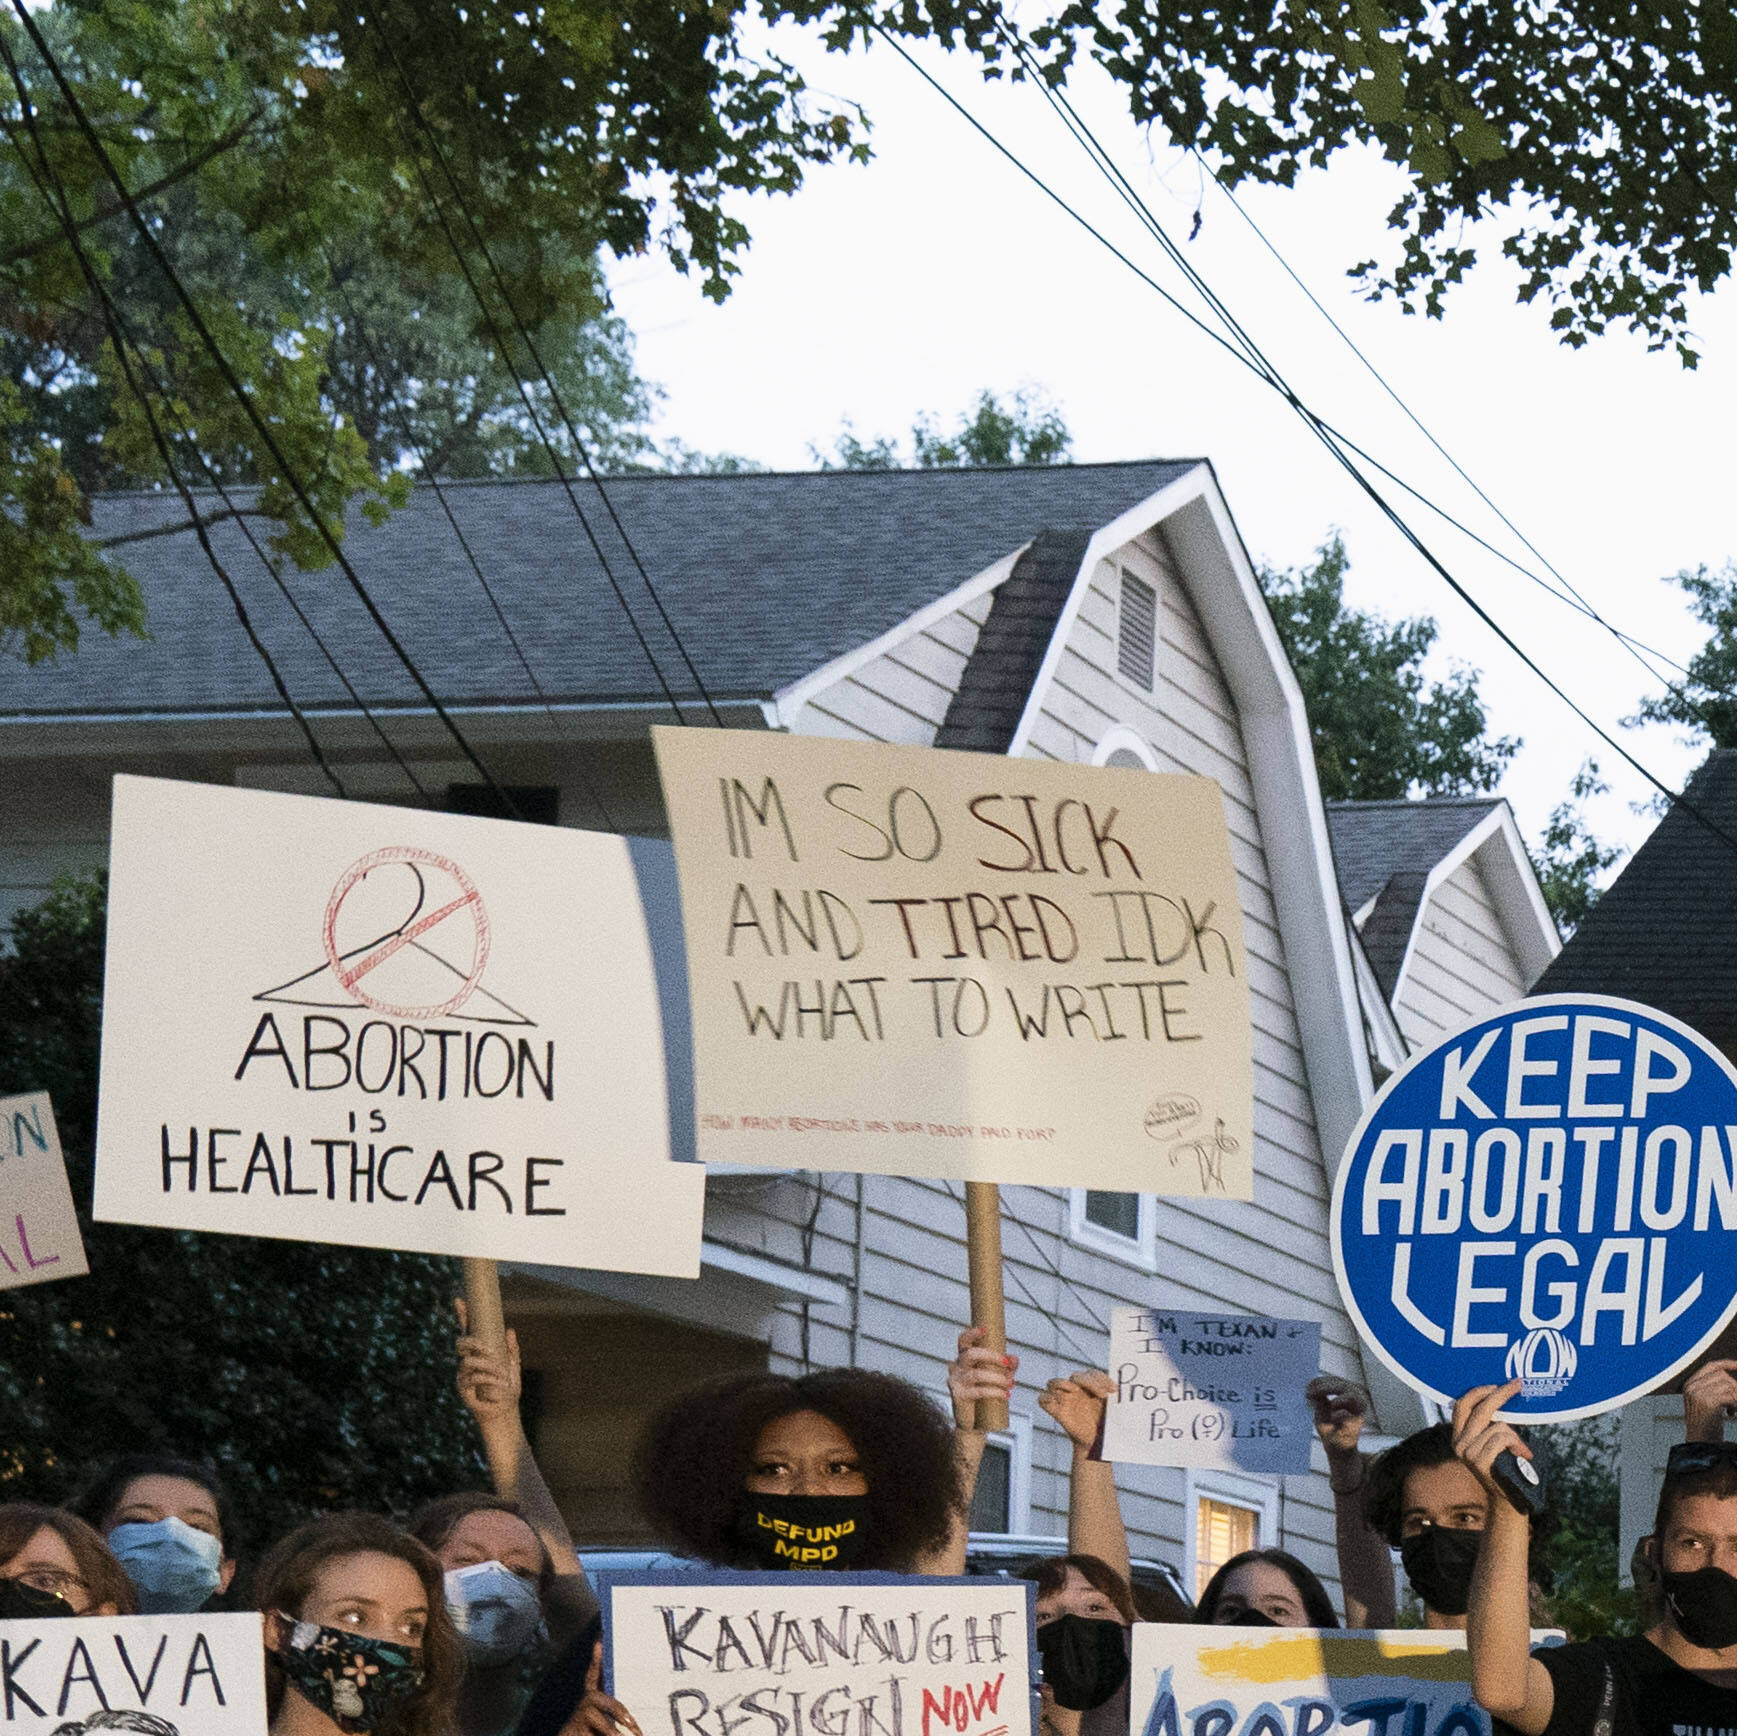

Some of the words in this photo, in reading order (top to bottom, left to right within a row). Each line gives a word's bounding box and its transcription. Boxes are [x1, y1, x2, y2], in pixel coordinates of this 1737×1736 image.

[823, 782, 941, 863] SO
[968, 793, 1144, 880] SICK
[724, 883, 866, 960] AND
[870, 896, 1079, 964] TIRED
[1091, 890, 1236, 978] IDK
[733, 976, 886, 1042] WHAT
[910, 977, 991, 1040] TO
[1004, 980, 1204, 1042] WRITE
[234, 1013, 556, 1102] ABORTION
[1438, 1012, 1694, 1124] KEEP
[159, 1123, 567, 1218] HEALTHCARE
[1128, 1313, 1178, 1335] I'M
[1193, 1319, 1279, 1340] TEXAN
[1389, 1235, 1704, 1349] LEGAL
[1136, 1336, 1164, 1355] I
[1505, 1328, 1578, 1378] NOW
[1117, 1361, 1241, 1405] Pro-Choice
[1254, 1386, 1278, 1403] is
[1148, 1407, 1185, 1443] Pro
[1231, 1418, 1282, 1440] Life
[757, 1511, 856, 1544] DEFUND
[774, 1538, 839, 1563] MPD
[654, 1604, 1019, 1676] KAVANAUGH
[0, 1631, 227, 1722] KAVA
